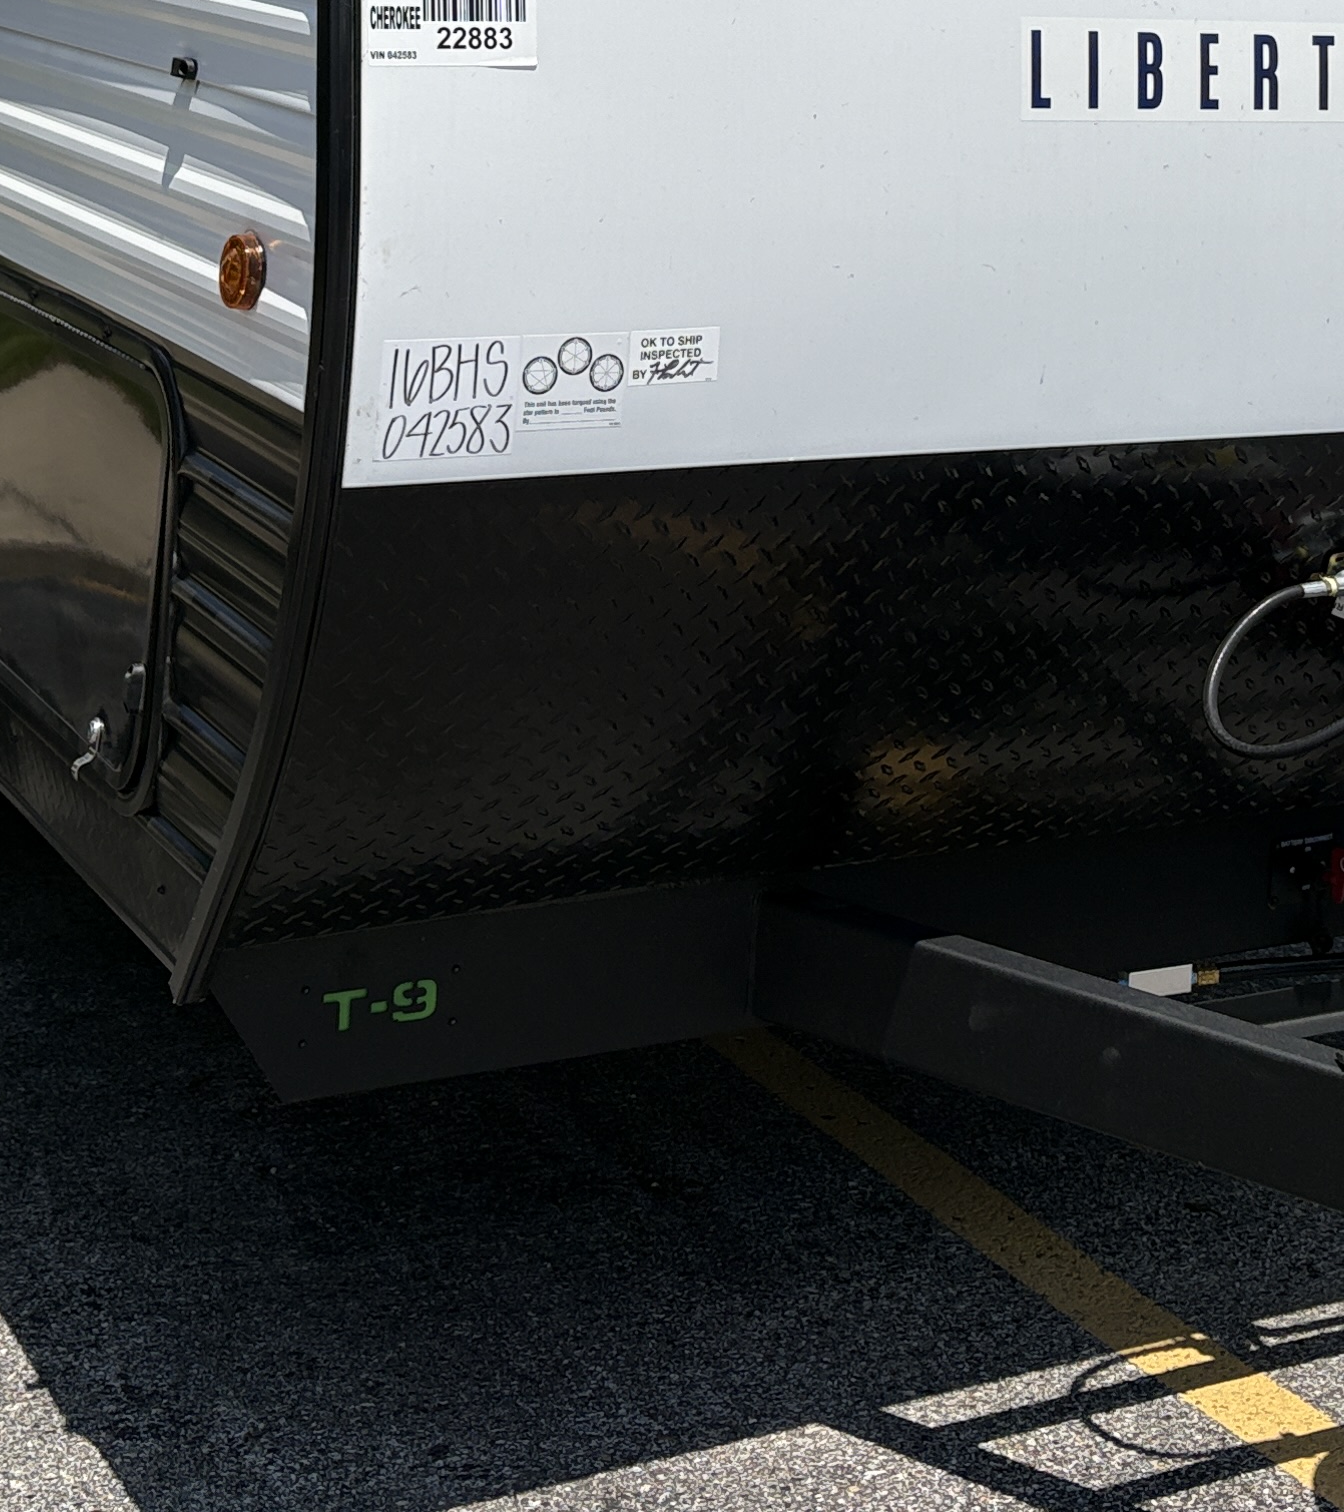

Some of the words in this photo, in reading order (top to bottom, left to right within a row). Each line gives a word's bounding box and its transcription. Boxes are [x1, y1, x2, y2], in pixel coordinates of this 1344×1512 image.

[370, 6, 422, 30] CHEROKEE
[437, 27, 513, 50] 22883
[370, 51, 385, 59] VIN
[641, 338, 657, 348] OK
[660, 336, 675, 347] TO
[677, 335, 703, 346] SHIP
[640, 347, 702, 361] INSPECTED
[388, 340, 509, 409] 16BHS
[632, 369, 647, 380] BY
[382, 404, 513, 459] 042583
[323, 979, 437, 1031] T-9
